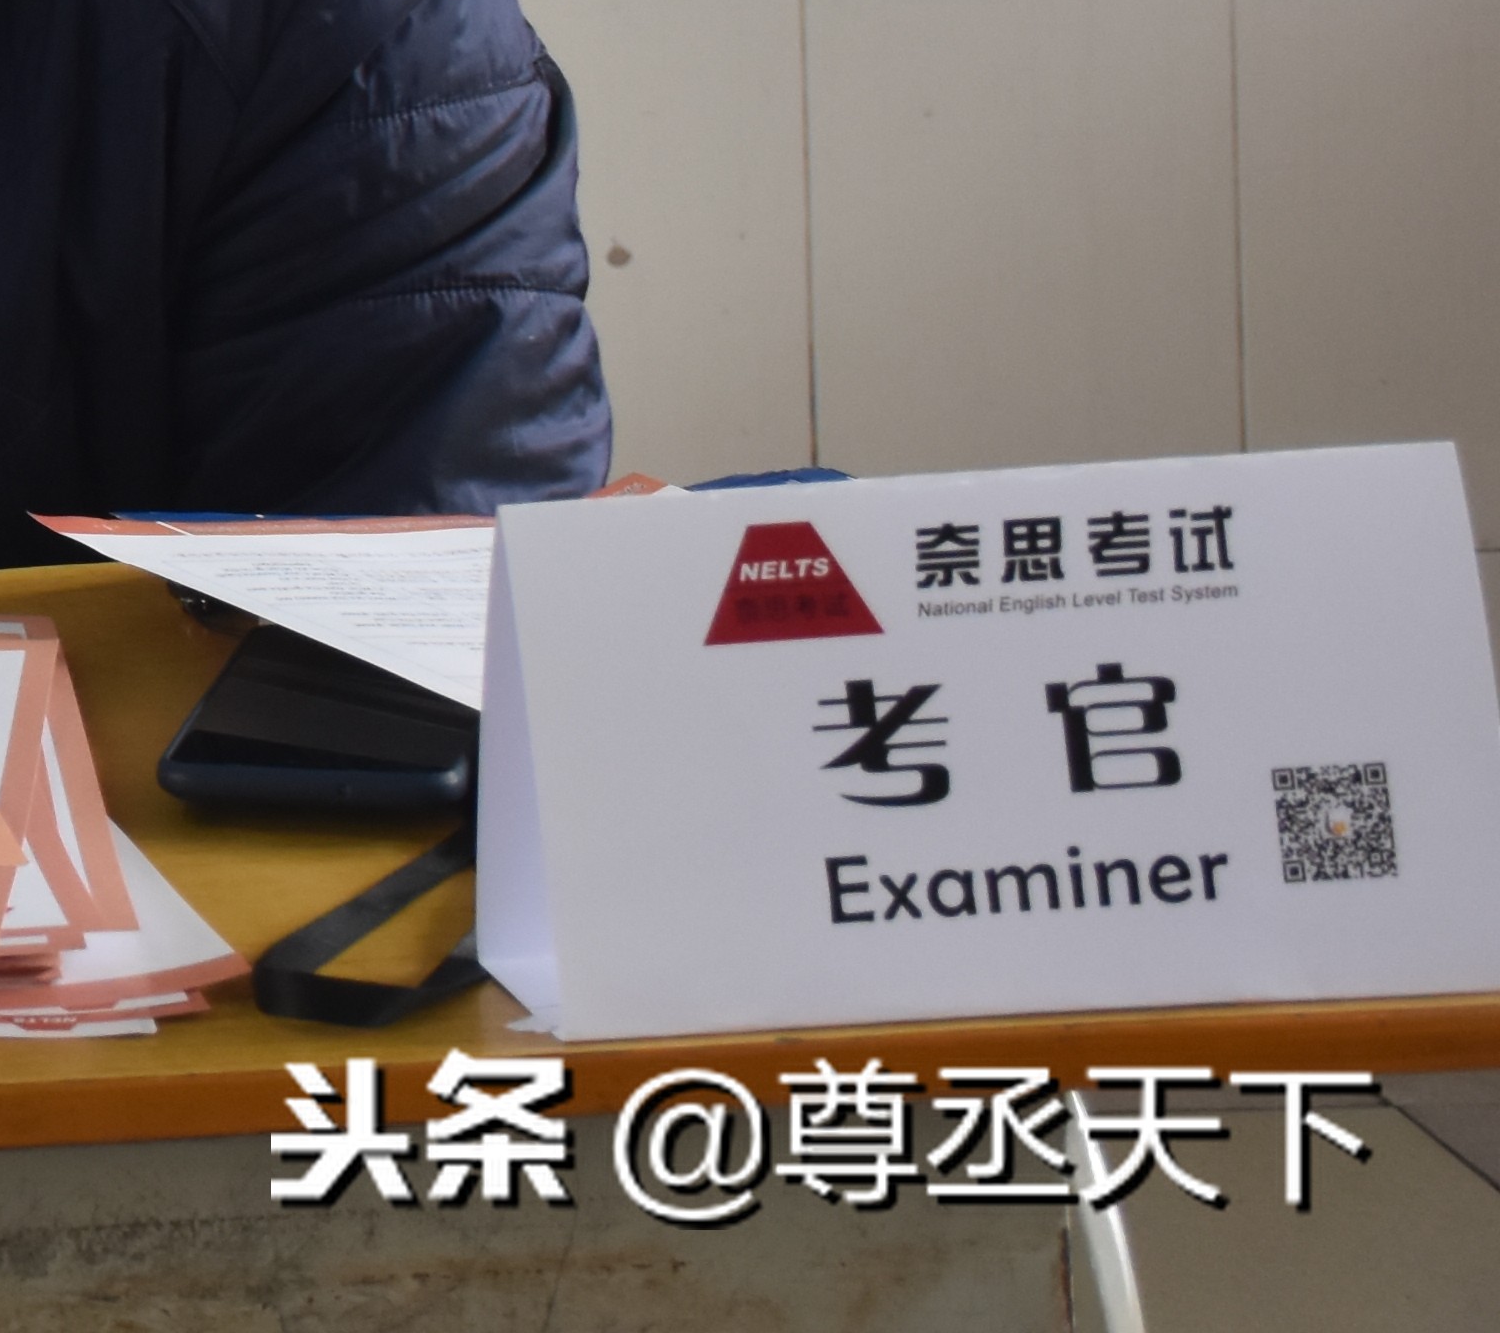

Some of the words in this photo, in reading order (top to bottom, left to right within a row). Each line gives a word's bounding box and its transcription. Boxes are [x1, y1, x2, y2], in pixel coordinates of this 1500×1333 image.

[739, 556, 830, 582] NELTS
[914, 505, 1235, 590] 奈思考试
[917, 598, 994, 620] National
[999, 592, 1067, 616] English
[1072, 590, 1122, 609] Level
[1128, 587, 1166, 606] Test
[1170, 582, 1240, 606] System
[812, 662, 1182, 807] 考官
[825, 844, 1229, 924] Examiner
